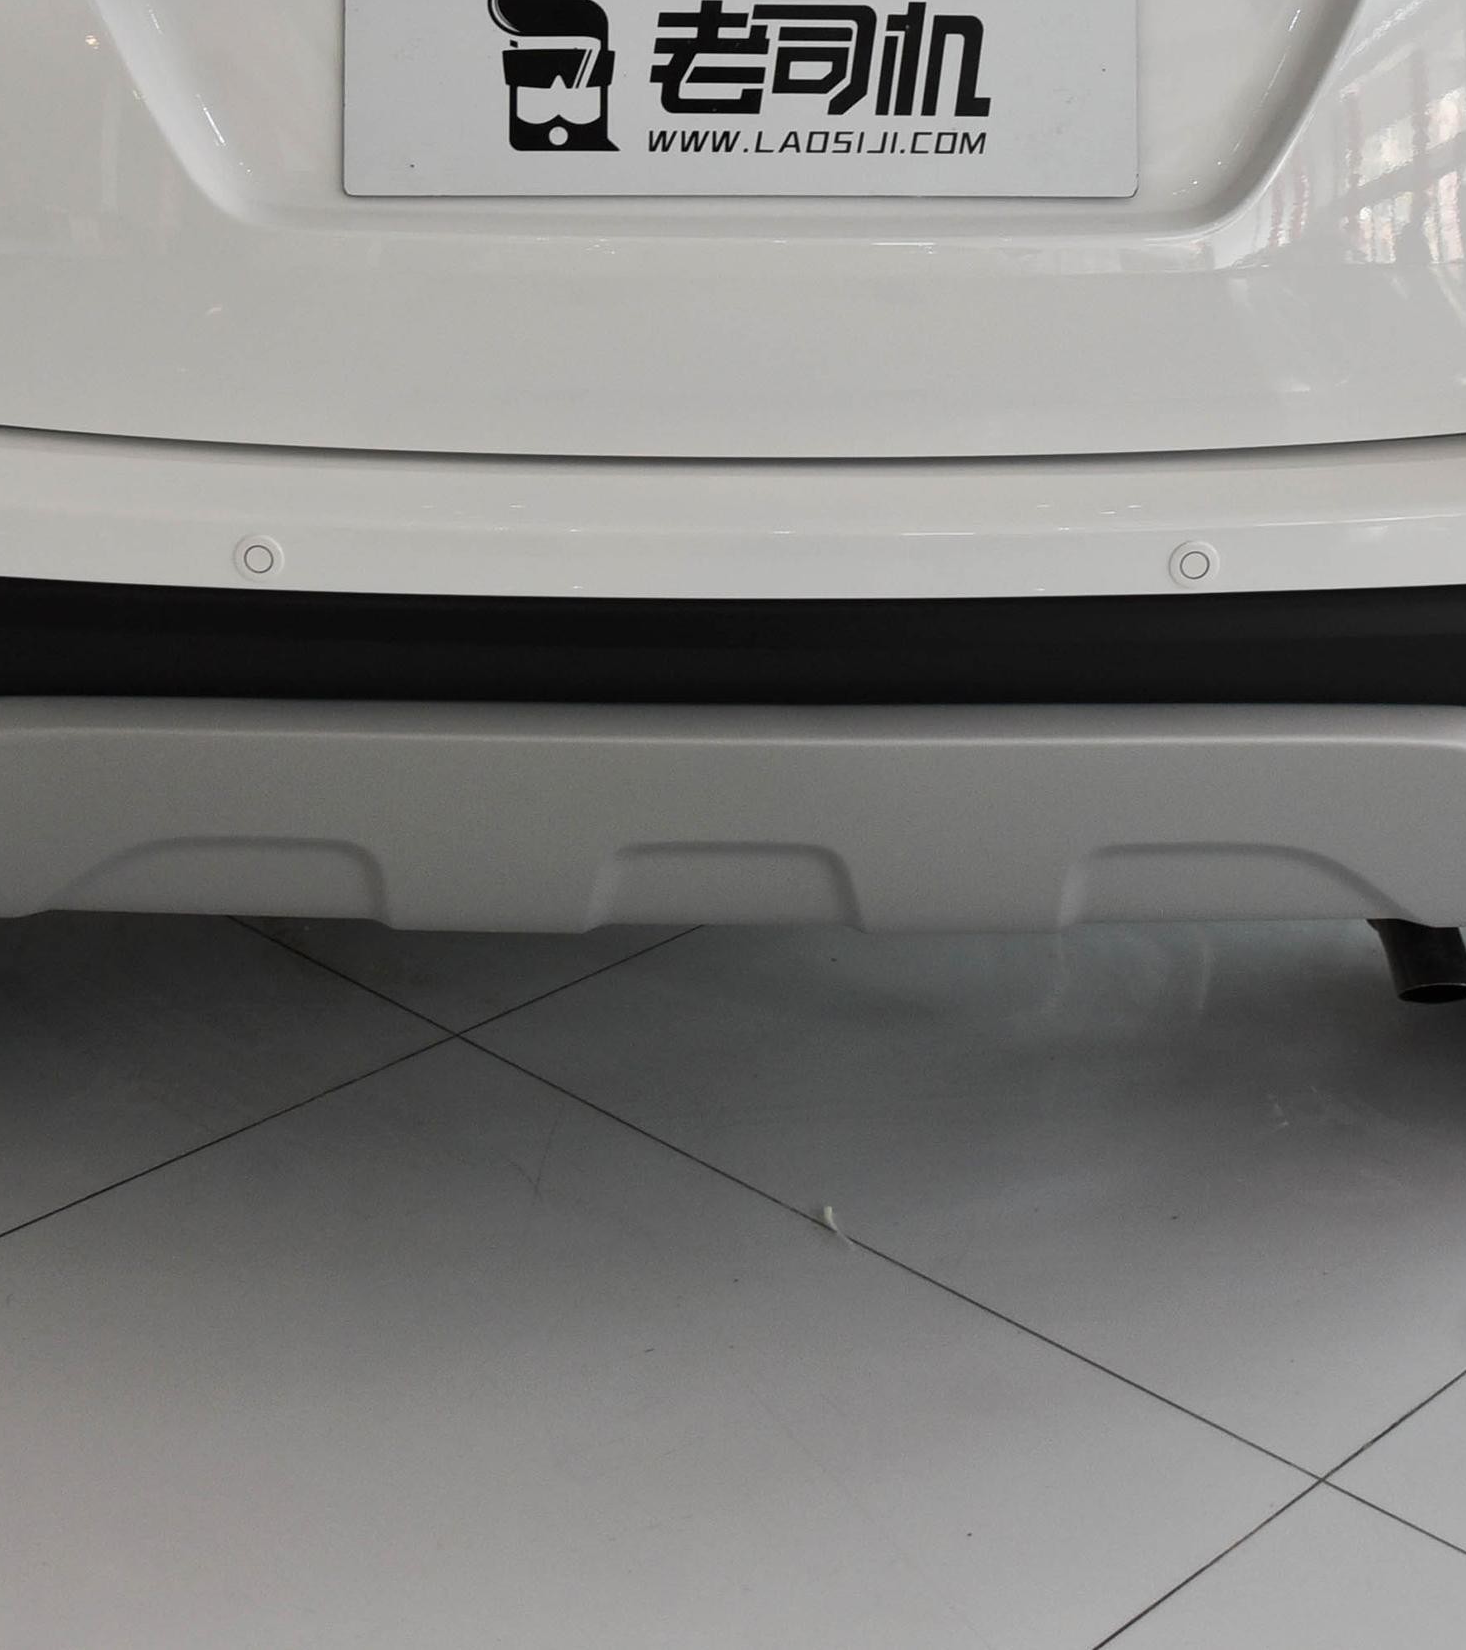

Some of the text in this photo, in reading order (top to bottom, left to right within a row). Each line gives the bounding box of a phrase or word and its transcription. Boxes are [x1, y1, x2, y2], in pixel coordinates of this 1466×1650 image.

[649, 0, 991, 116] 老司机
[648, 130, 987, 154] WWW.LAOSIJI.COM
